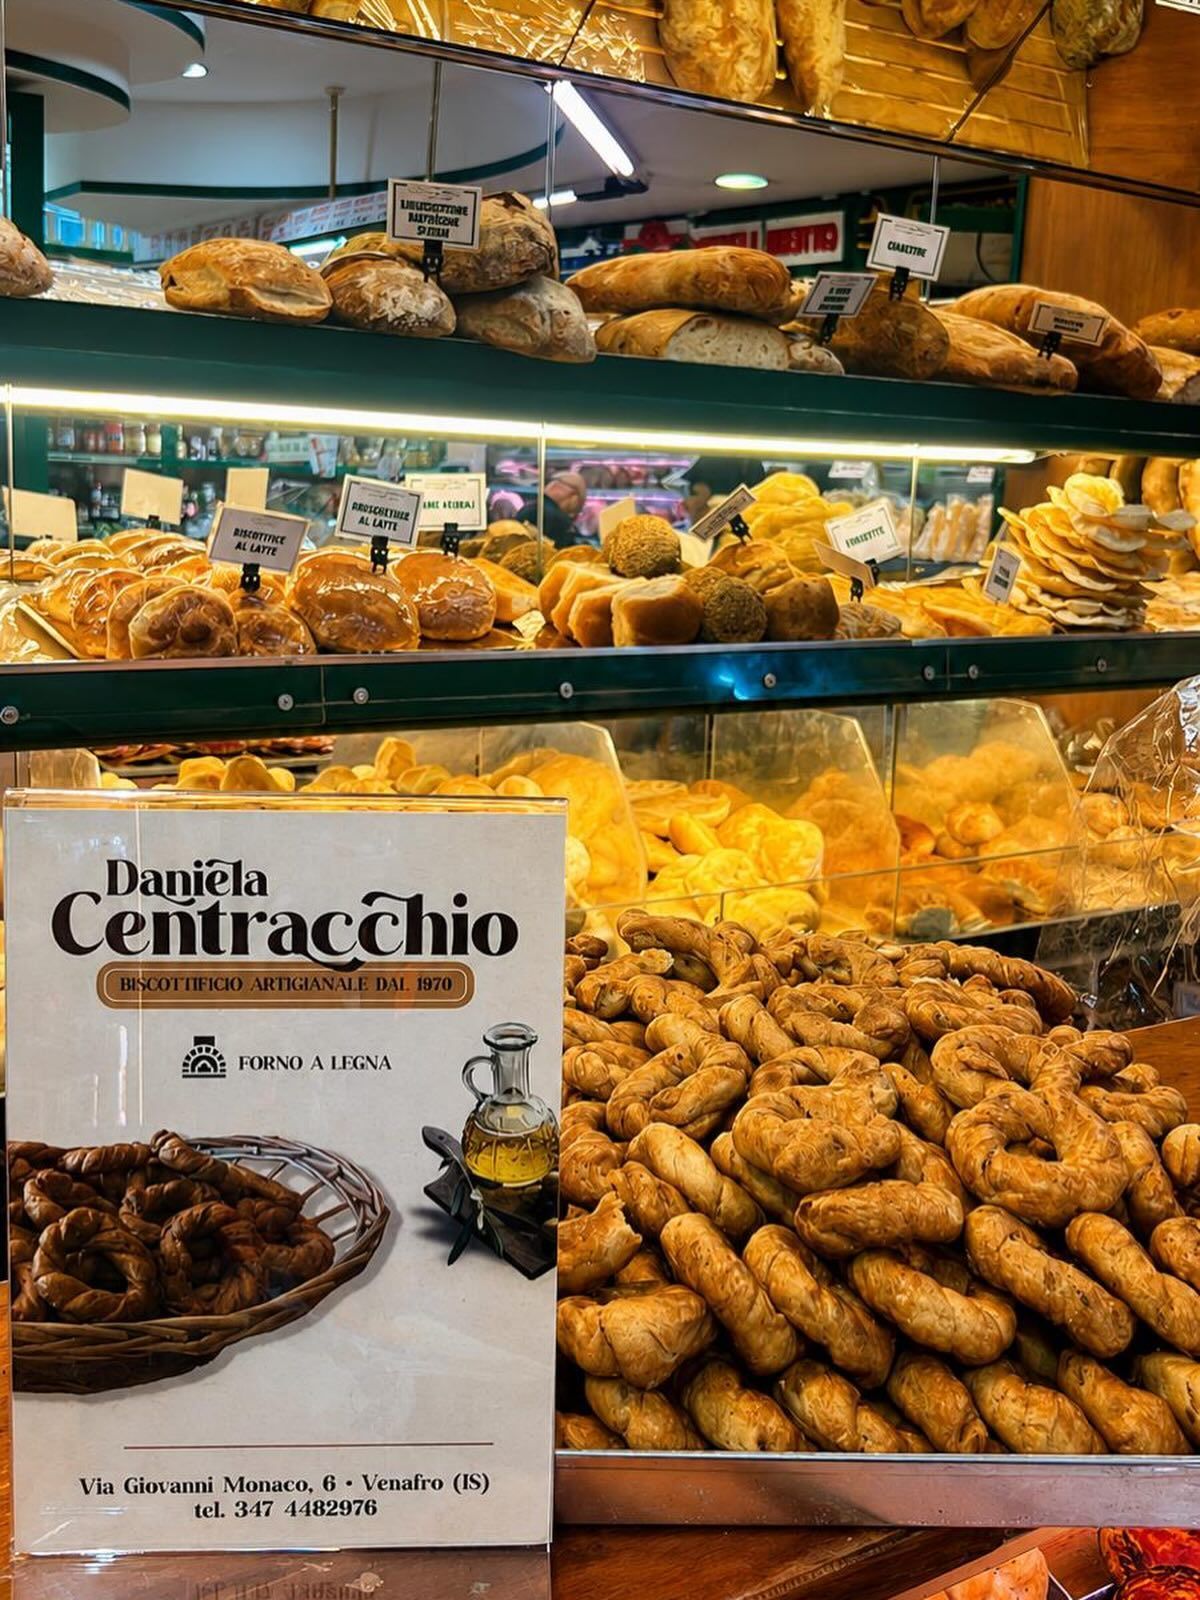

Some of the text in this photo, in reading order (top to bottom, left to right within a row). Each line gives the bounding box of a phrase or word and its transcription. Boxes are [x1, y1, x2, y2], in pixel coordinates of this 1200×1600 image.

[235, 541, 278, 556] AL LATTE
[106, 858, 268, 904] Daniela
[51, 890, 519, 971] Centracchio
[120, 976, 453, 992] BISCOTTIFICIO ARTIGIANALE DAL 1970
[239, 1055, 392, 1071] FORNO A LEGNA
[79, 1472, 490, 1495] Via Giovanni Monaco, 6 Venafro (IS)
[194, 1499, 378, 1519] tel. 347 4482976
